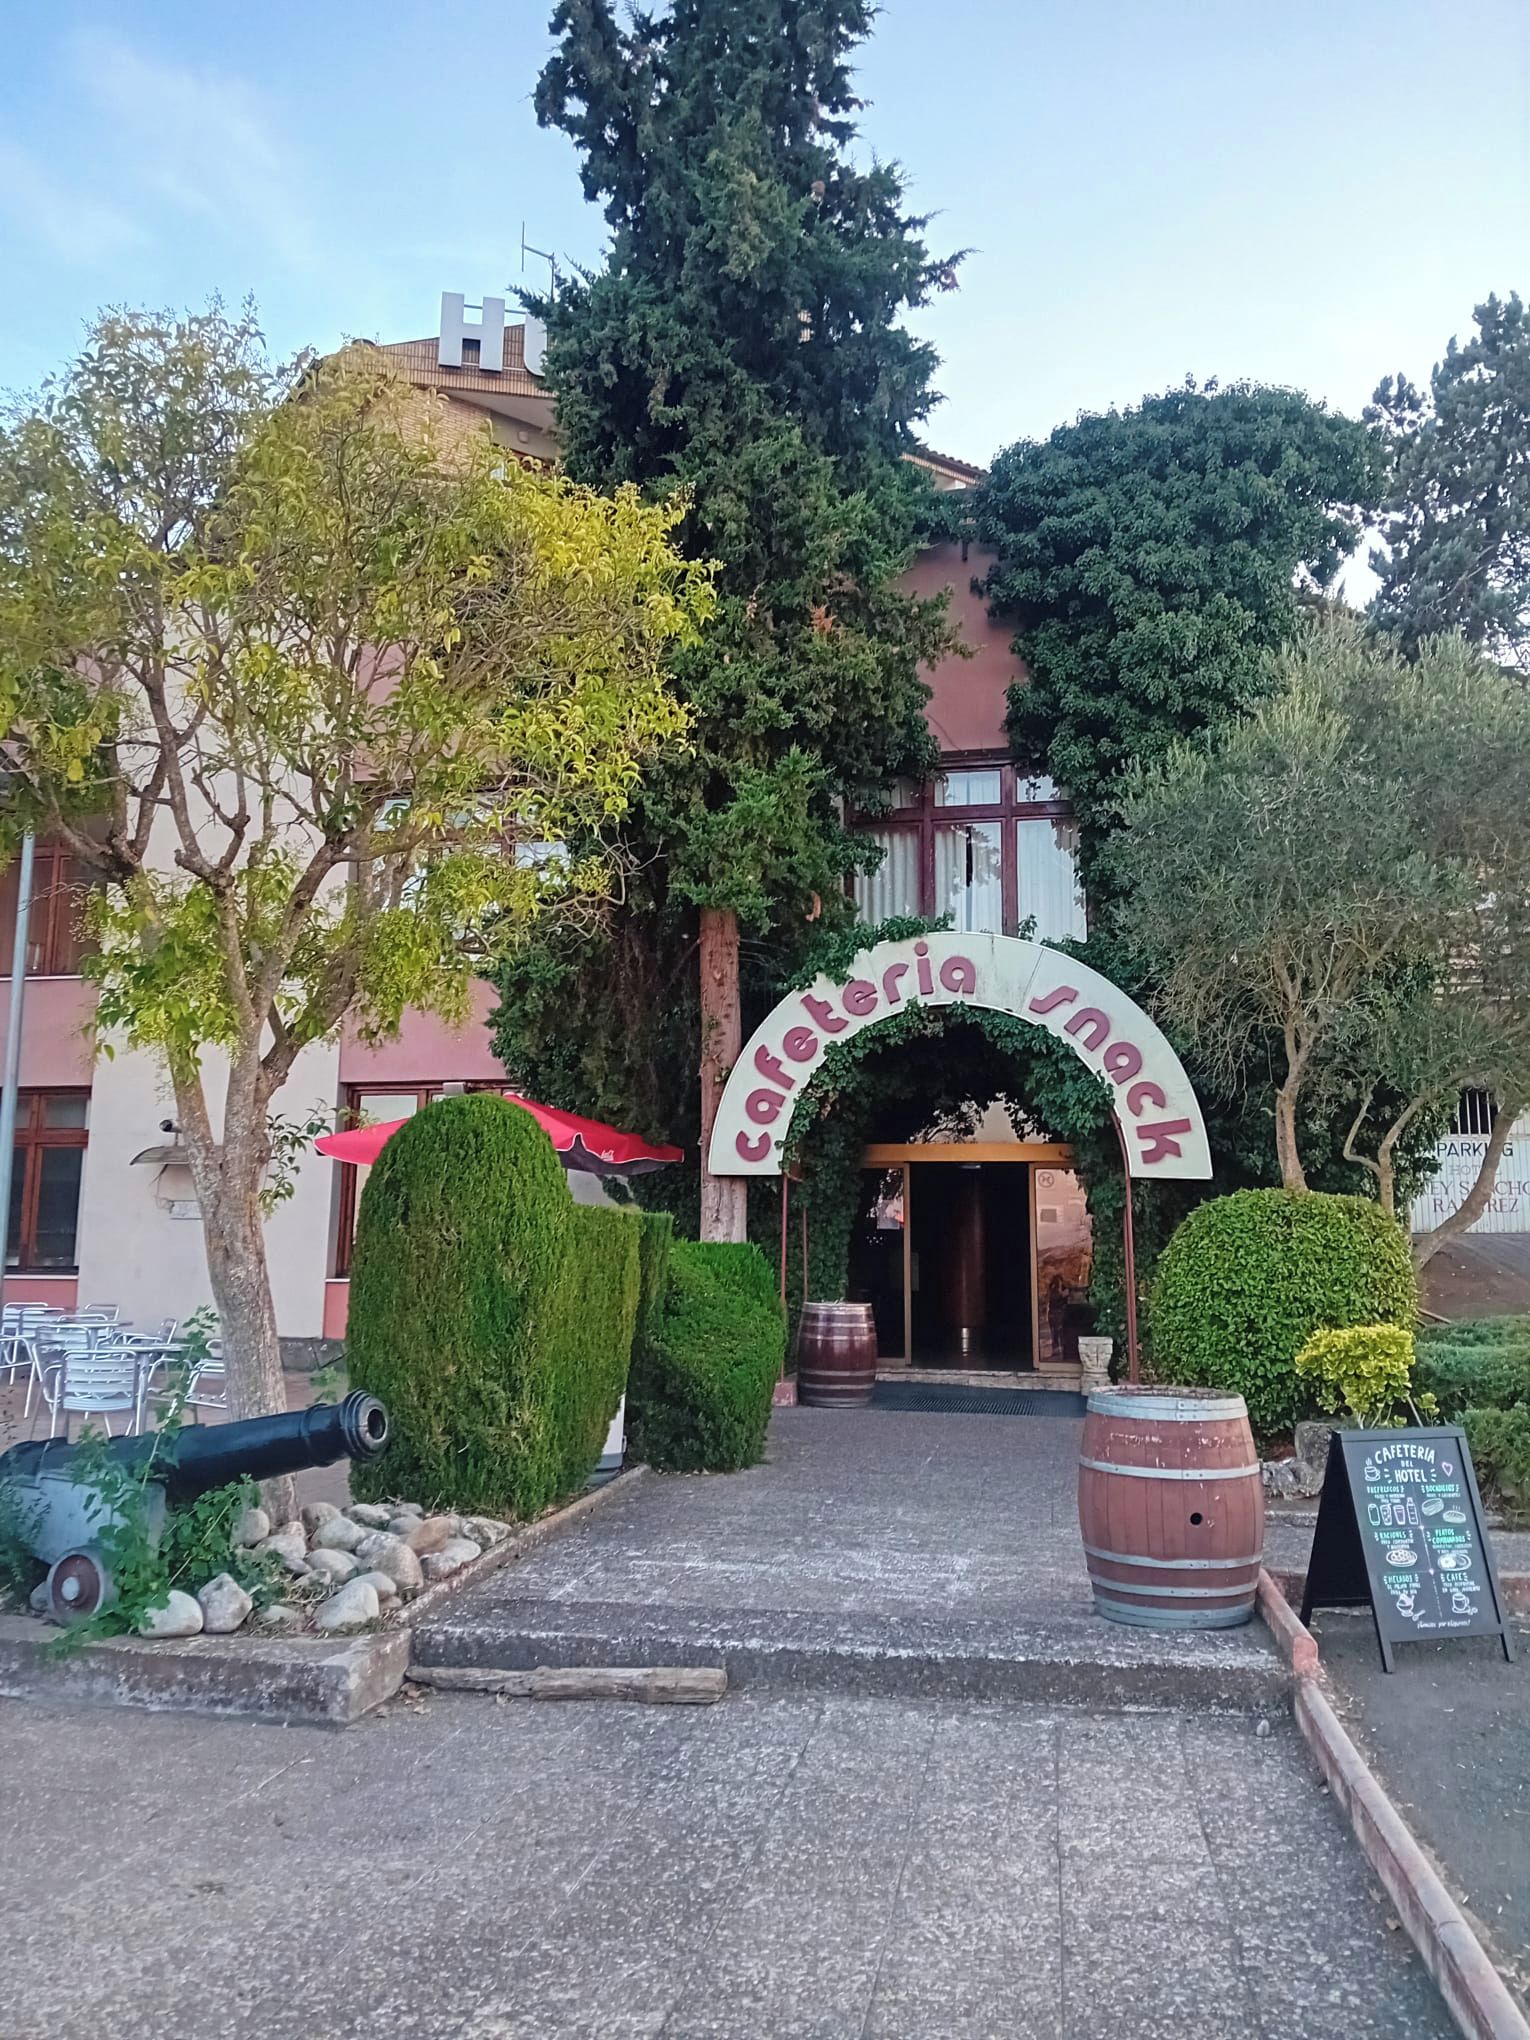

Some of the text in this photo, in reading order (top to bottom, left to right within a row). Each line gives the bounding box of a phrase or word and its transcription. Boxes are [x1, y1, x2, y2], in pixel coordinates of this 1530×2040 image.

[735, 941, 977, 1163] cafeteria
[1436, 1142, 1514, 1157] PARKIG
[1425, 1181, 1453, 1195] EY
[1433, 1198, 1519, 1213] RAREZ
[1394, 1469, 1428, 1483] HOTEL
[1435, 1528, 1455, 1536] PLATOS
